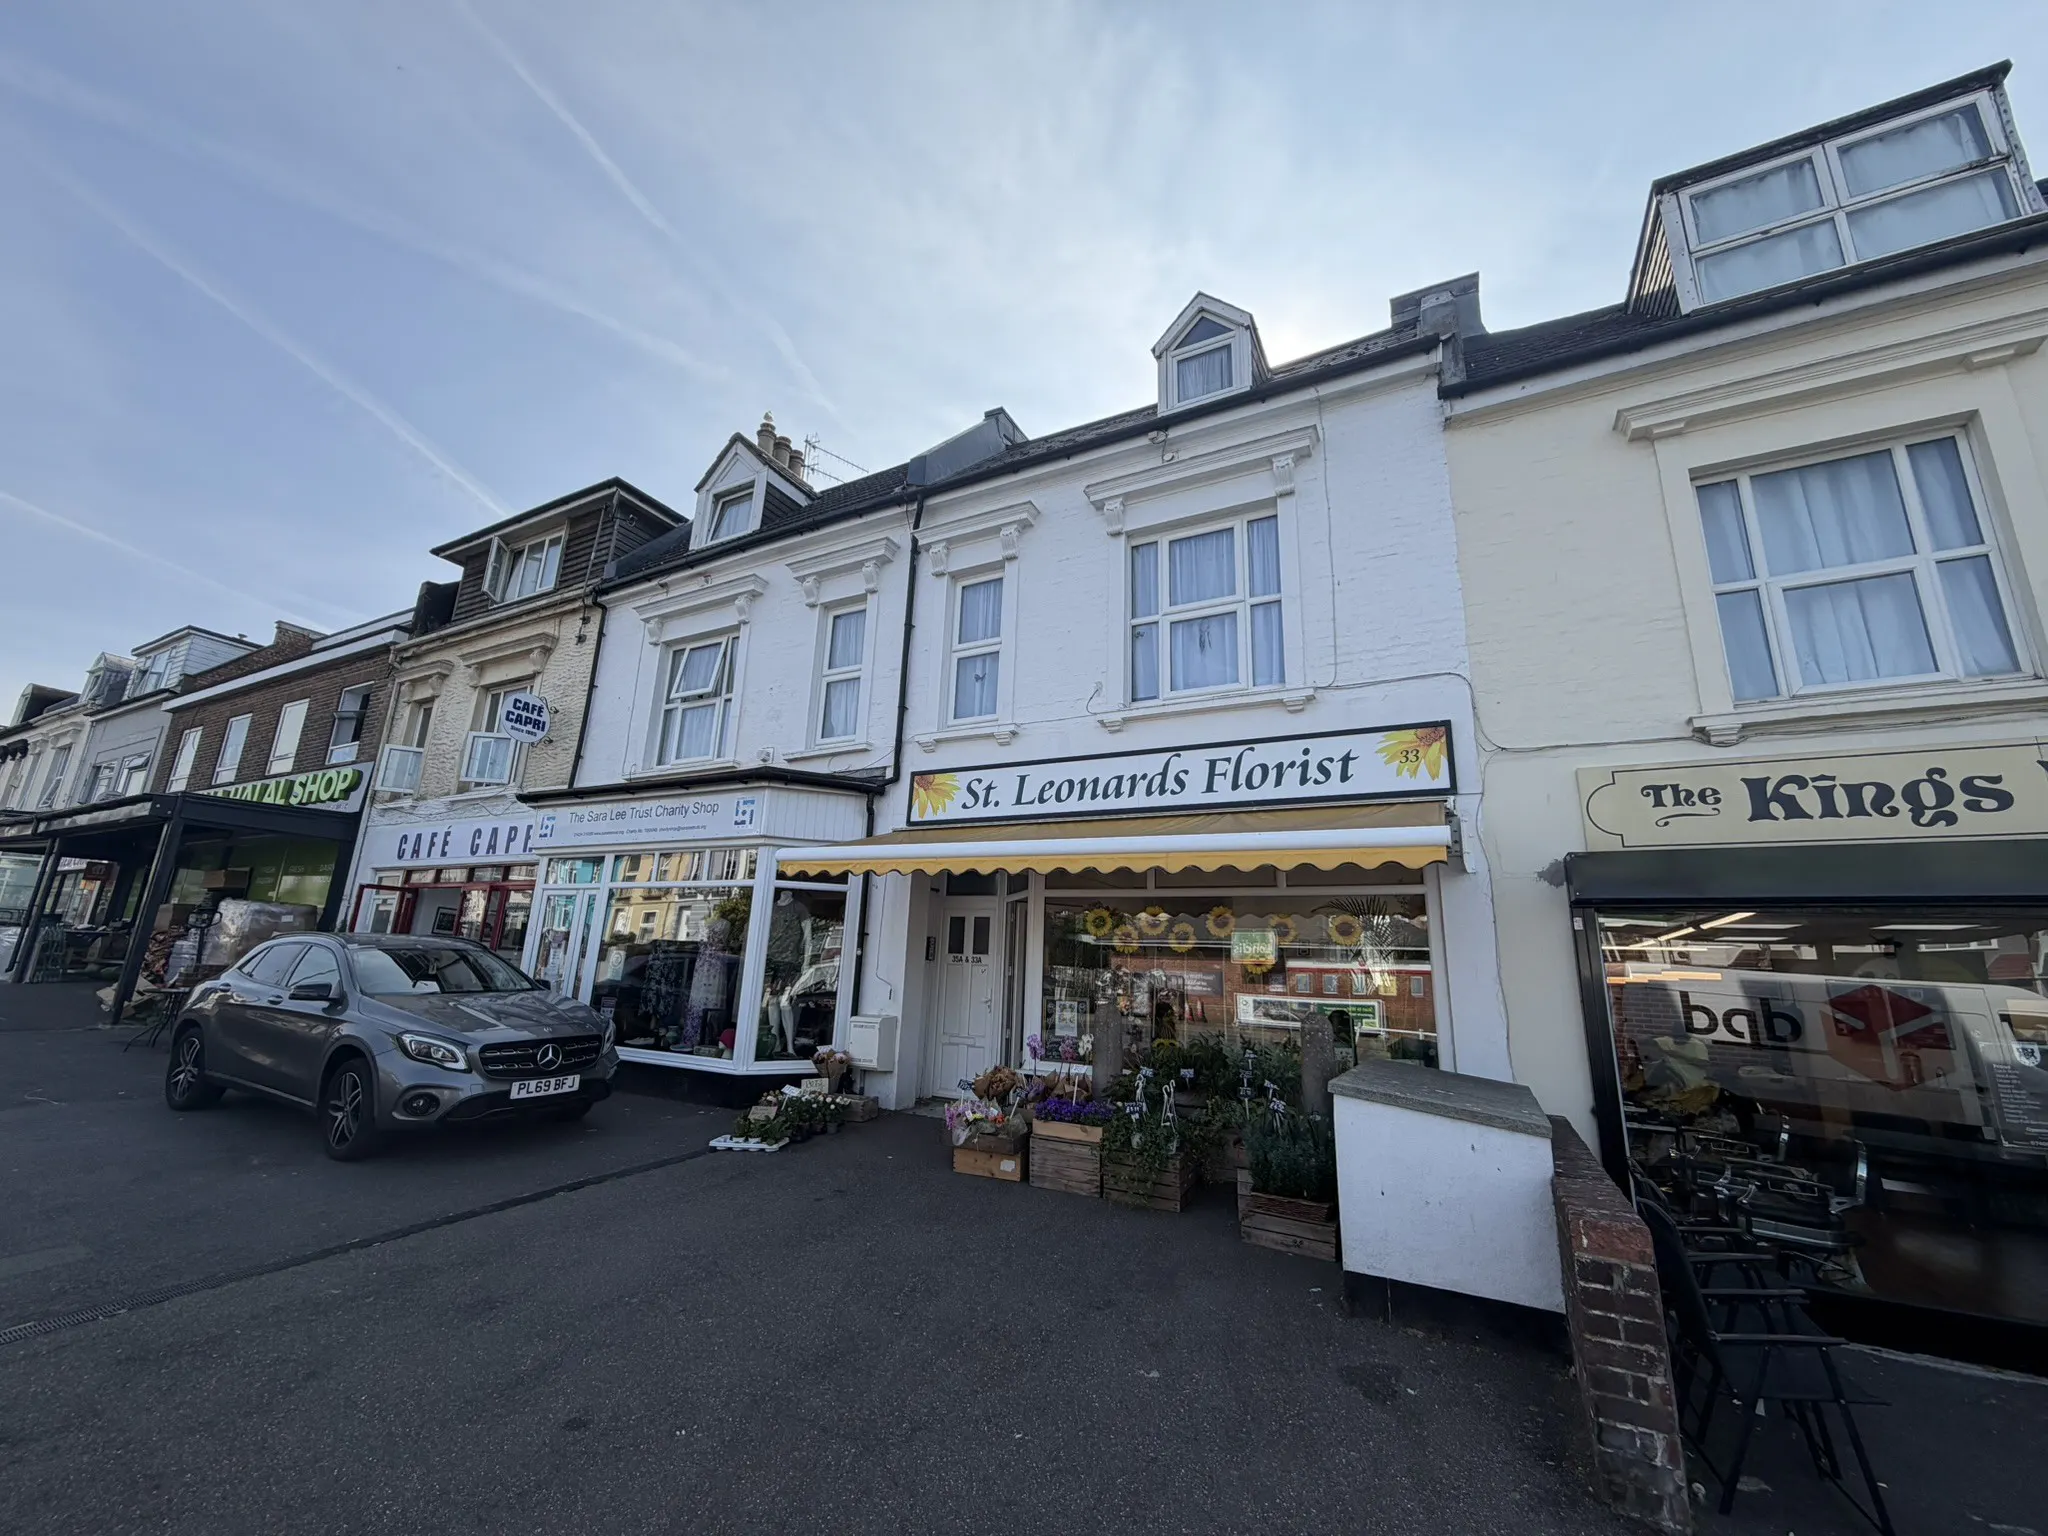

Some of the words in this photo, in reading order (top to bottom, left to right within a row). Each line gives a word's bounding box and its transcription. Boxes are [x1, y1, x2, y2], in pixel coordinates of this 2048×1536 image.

[512, 697, 545, 718] CAFÉ
[504, 709, 547, 733] CAPRI
[510, 724, 525, 734] Since
[1399, 748, 1421, 764] 33
[289, 767, 357, 806] SHOP
[961, 777, 1000, 810] St.
[1011, 752, 1190, 807] Leonards
[1201, 746, 1360, 795] Florist
[1640, 783, 1723, 810] The
[1740, 766, 2015, 828] Kings
[569, 811, 585, 824] The
[586, 810, 608, 823] Sara
[609, 808, 627, 821] Lee
[630, 805, 653, 820] Trust
[655, 803, 690, 819] Charity
[692, 801, 720, 817] Shop
[396, 824, 452, 861] CAFÉ
[516, 1079, 552, 1096] PL69
[553, 1075, 577, 1092] BFJ
